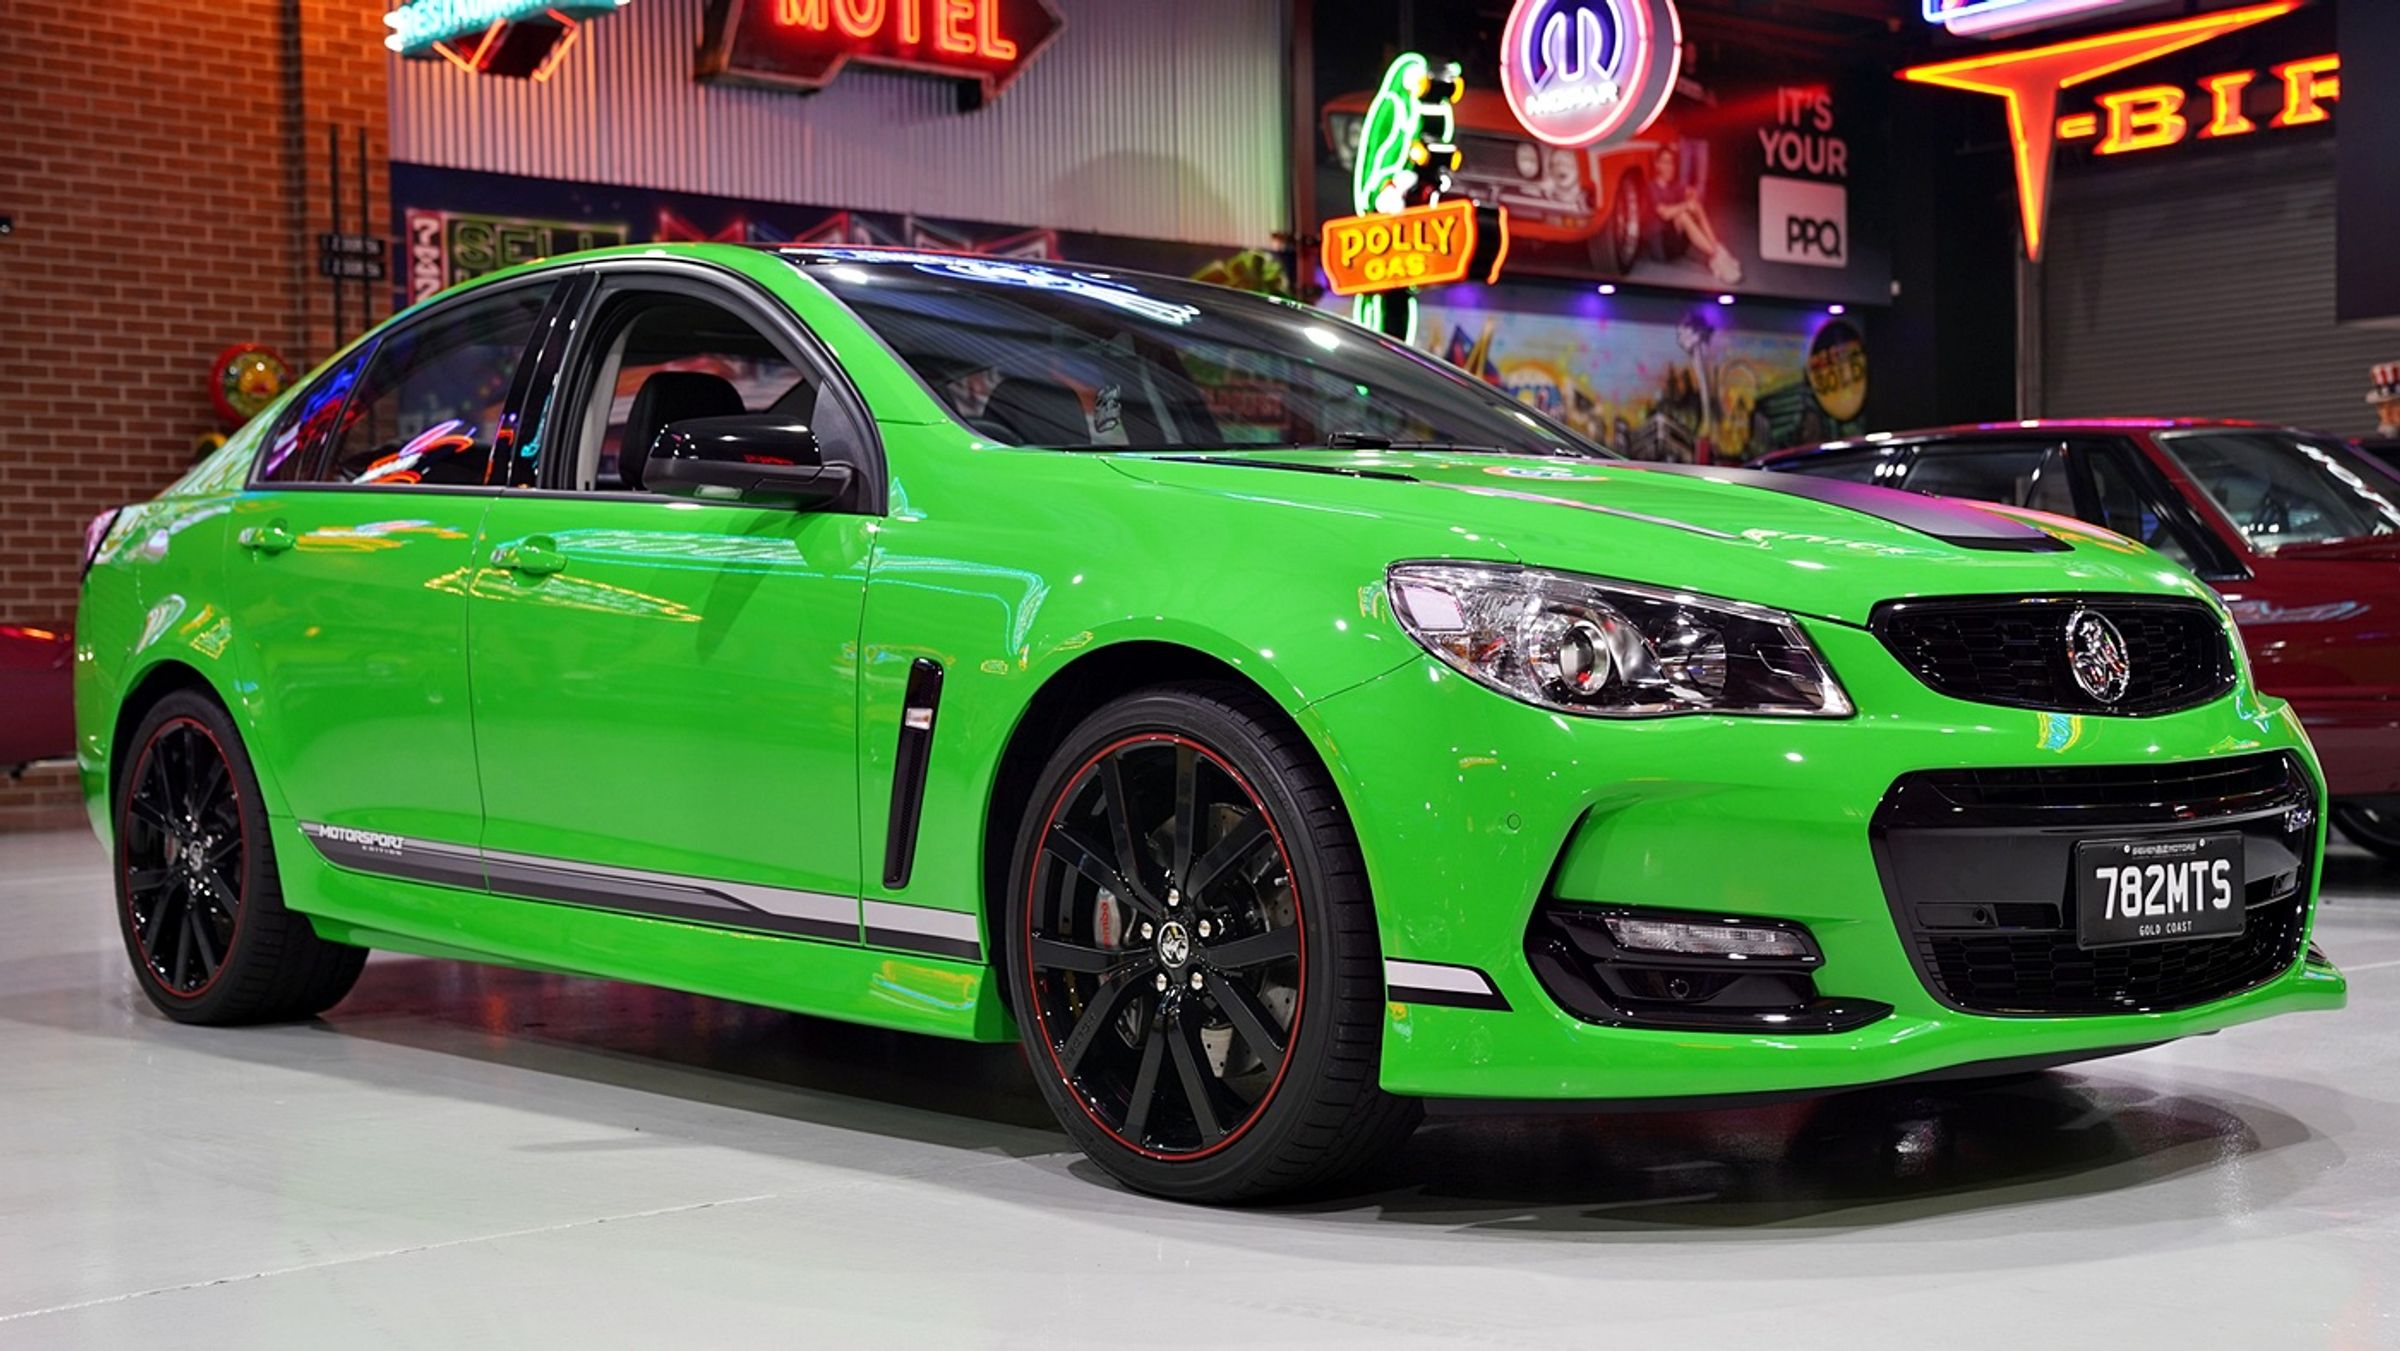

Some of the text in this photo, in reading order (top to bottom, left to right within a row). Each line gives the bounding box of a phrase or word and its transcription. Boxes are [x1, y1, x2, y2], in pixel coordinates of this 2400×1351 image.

[397, 0, 545, 40] RESTAU
[1777, 86, 1833, 132] IT'S
[1758, 127, 1848, 176] YOUR
[1338, 215, 1455, 267] POLLY
[1787, 214, 1842, 258] PPQ
[1364, 253, 1426, 281] GAS
[319, 824, 404, 850] MOTORSPORT
[2096, 859, 2232, 920] 782MTS
[2139, 921, 2193, 936] GOLD COAST
